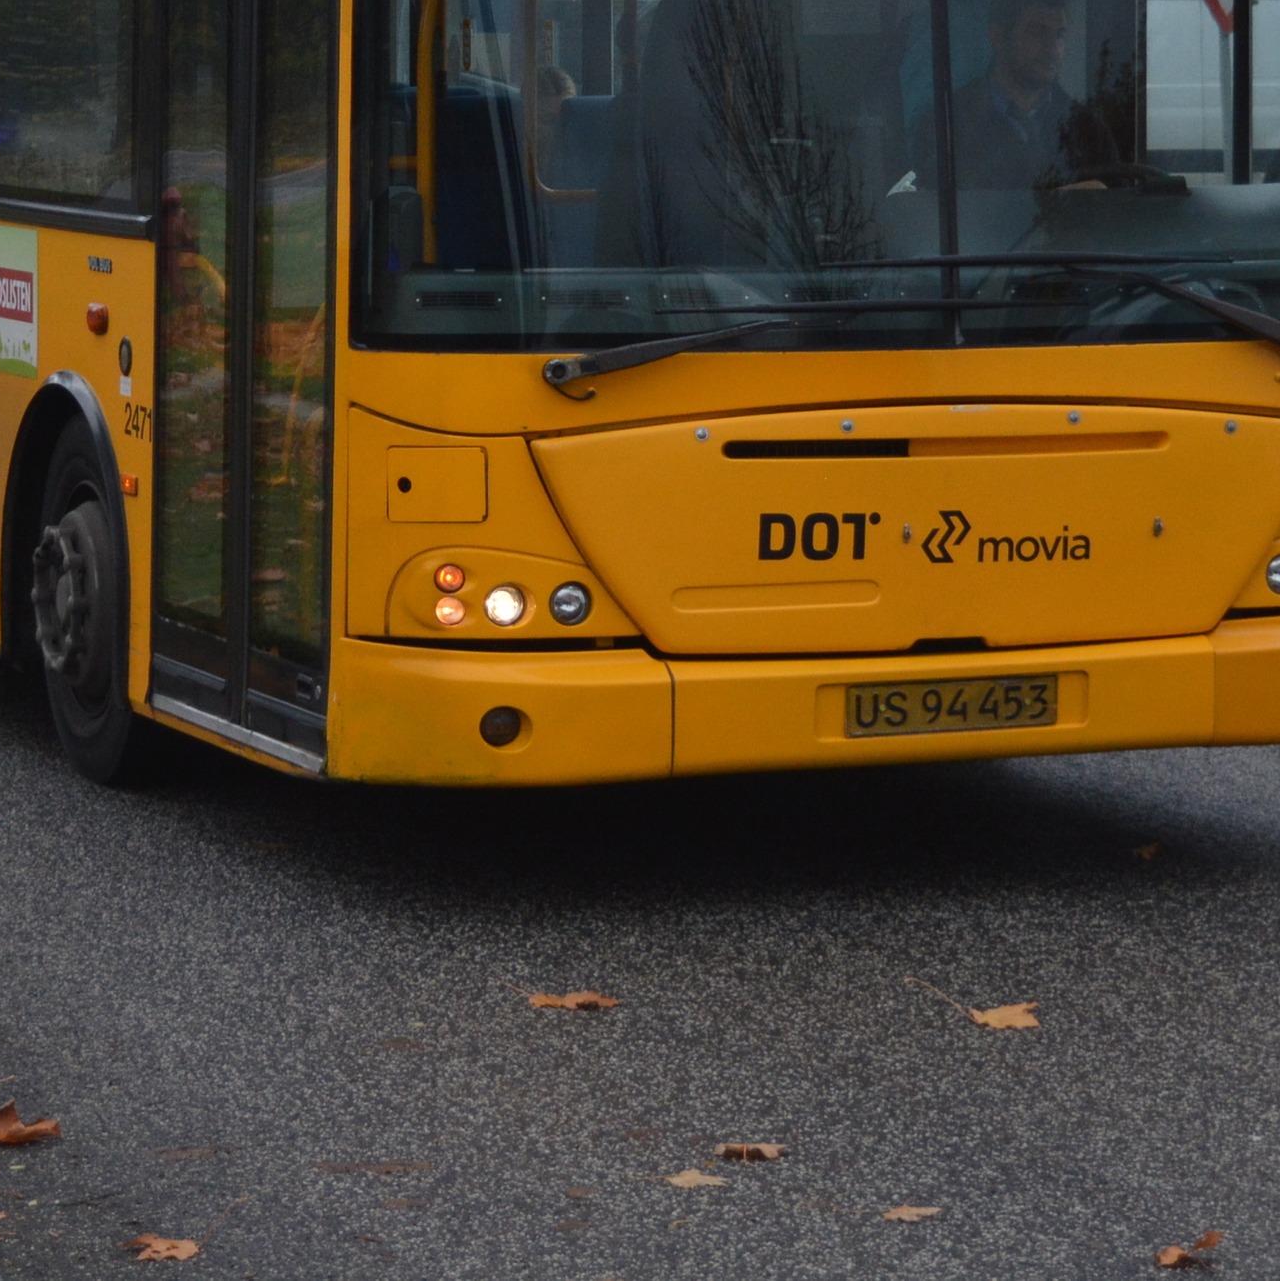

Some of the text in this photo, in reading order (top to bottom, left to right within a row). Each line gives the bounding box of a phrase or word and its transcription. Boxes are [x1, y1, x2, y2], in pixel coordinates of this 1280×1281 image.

[124, 401, 153, 444] 2471
[758, 512, 869, 561] DOT
[977, 525, 1091, 563] movia
[855, 684, 1048, 729] US 94 453
